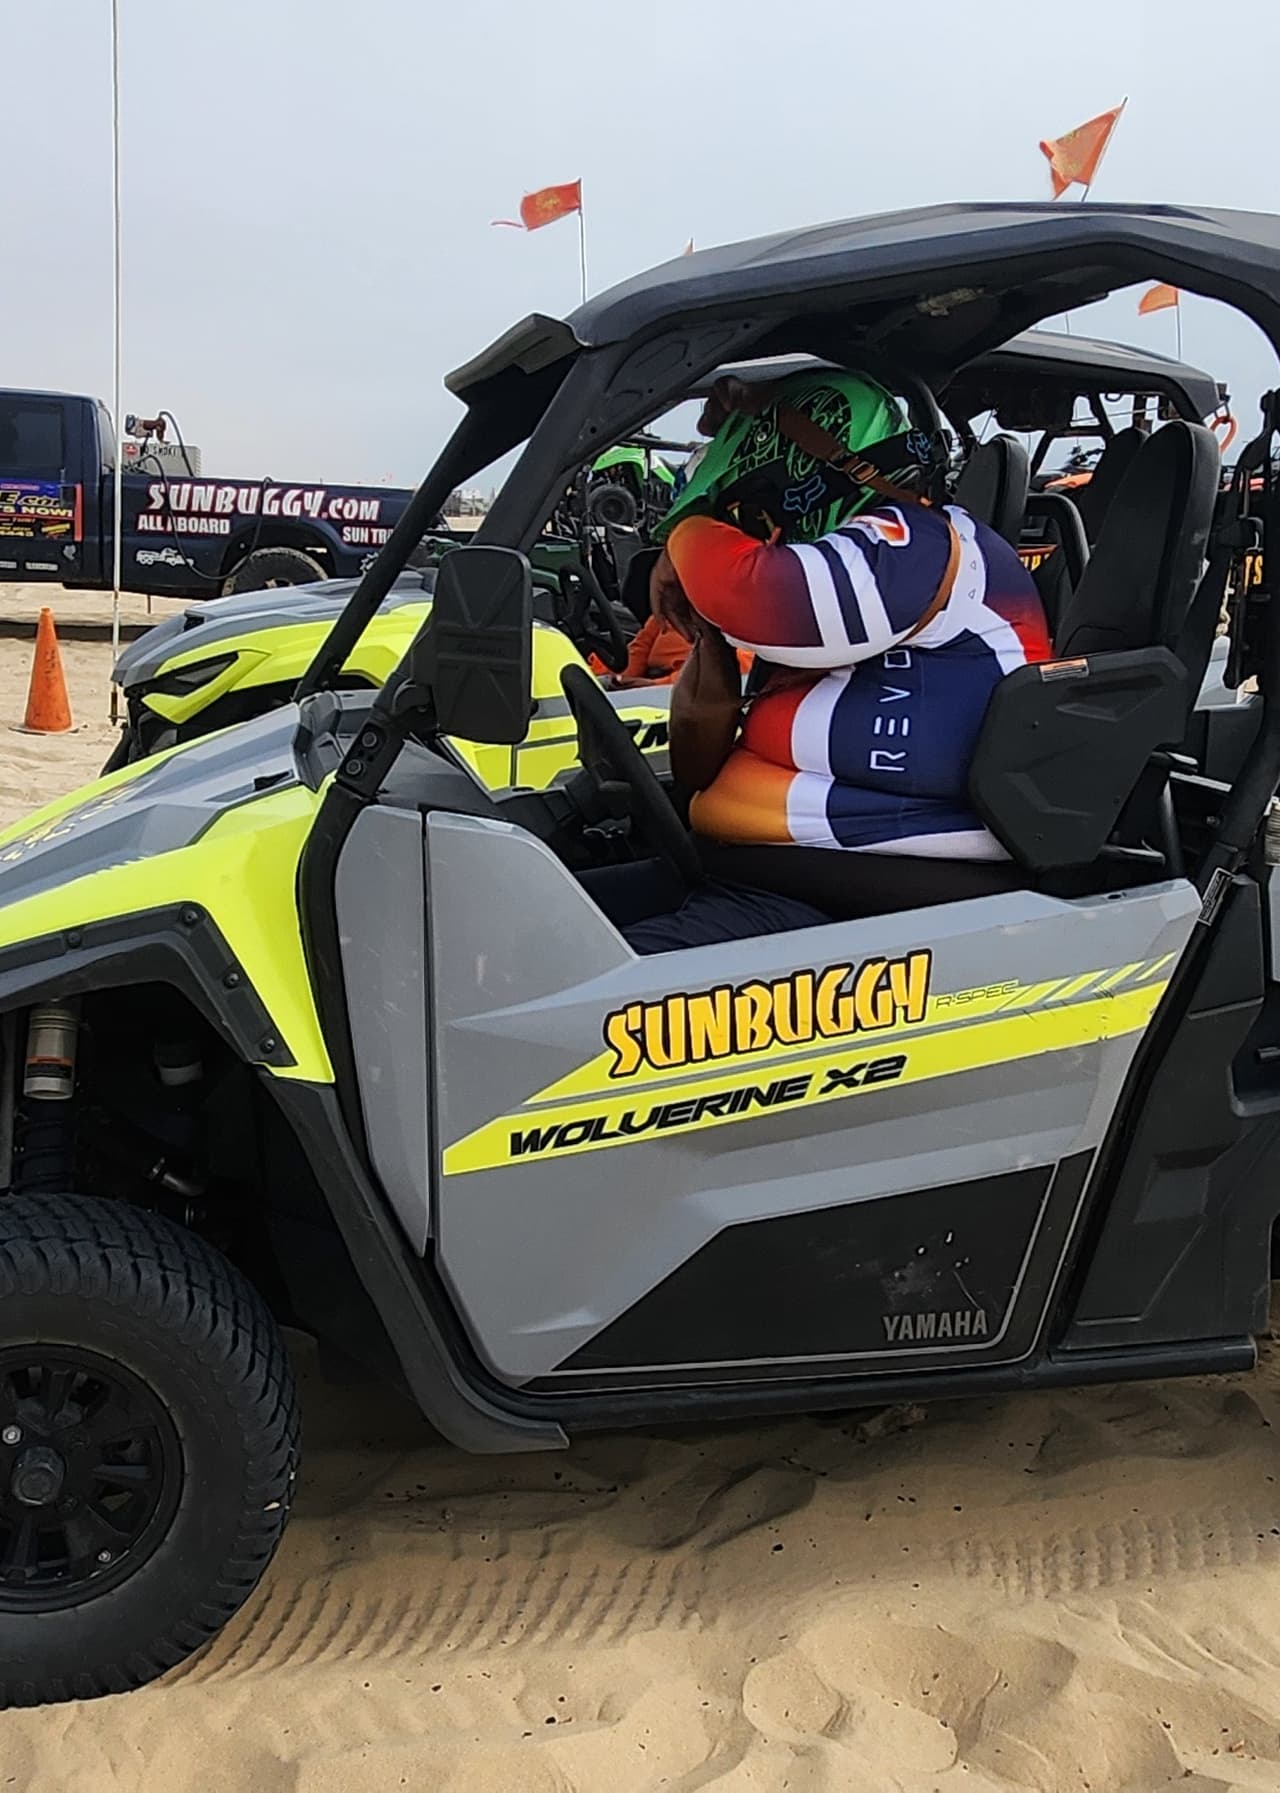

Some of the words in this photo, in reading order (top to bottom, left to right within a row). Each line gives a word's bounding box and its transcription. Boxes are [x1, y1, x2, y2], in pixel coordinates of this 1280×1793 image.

[148, 483, 381, 520] SUNBUGGY.COM
[137, 515, 164, 532] ALL
[167, 516, 230, 535] ABOARD
[342, 526, 369, 543] SUN
[604, 949, 934, 1078] SUNBUGGY
[509, 1073, 813, 1156] WOLVERINE
[818, 1054, 908, 1096] X2
[882, 1310, 988, 1342] YAMAHA
